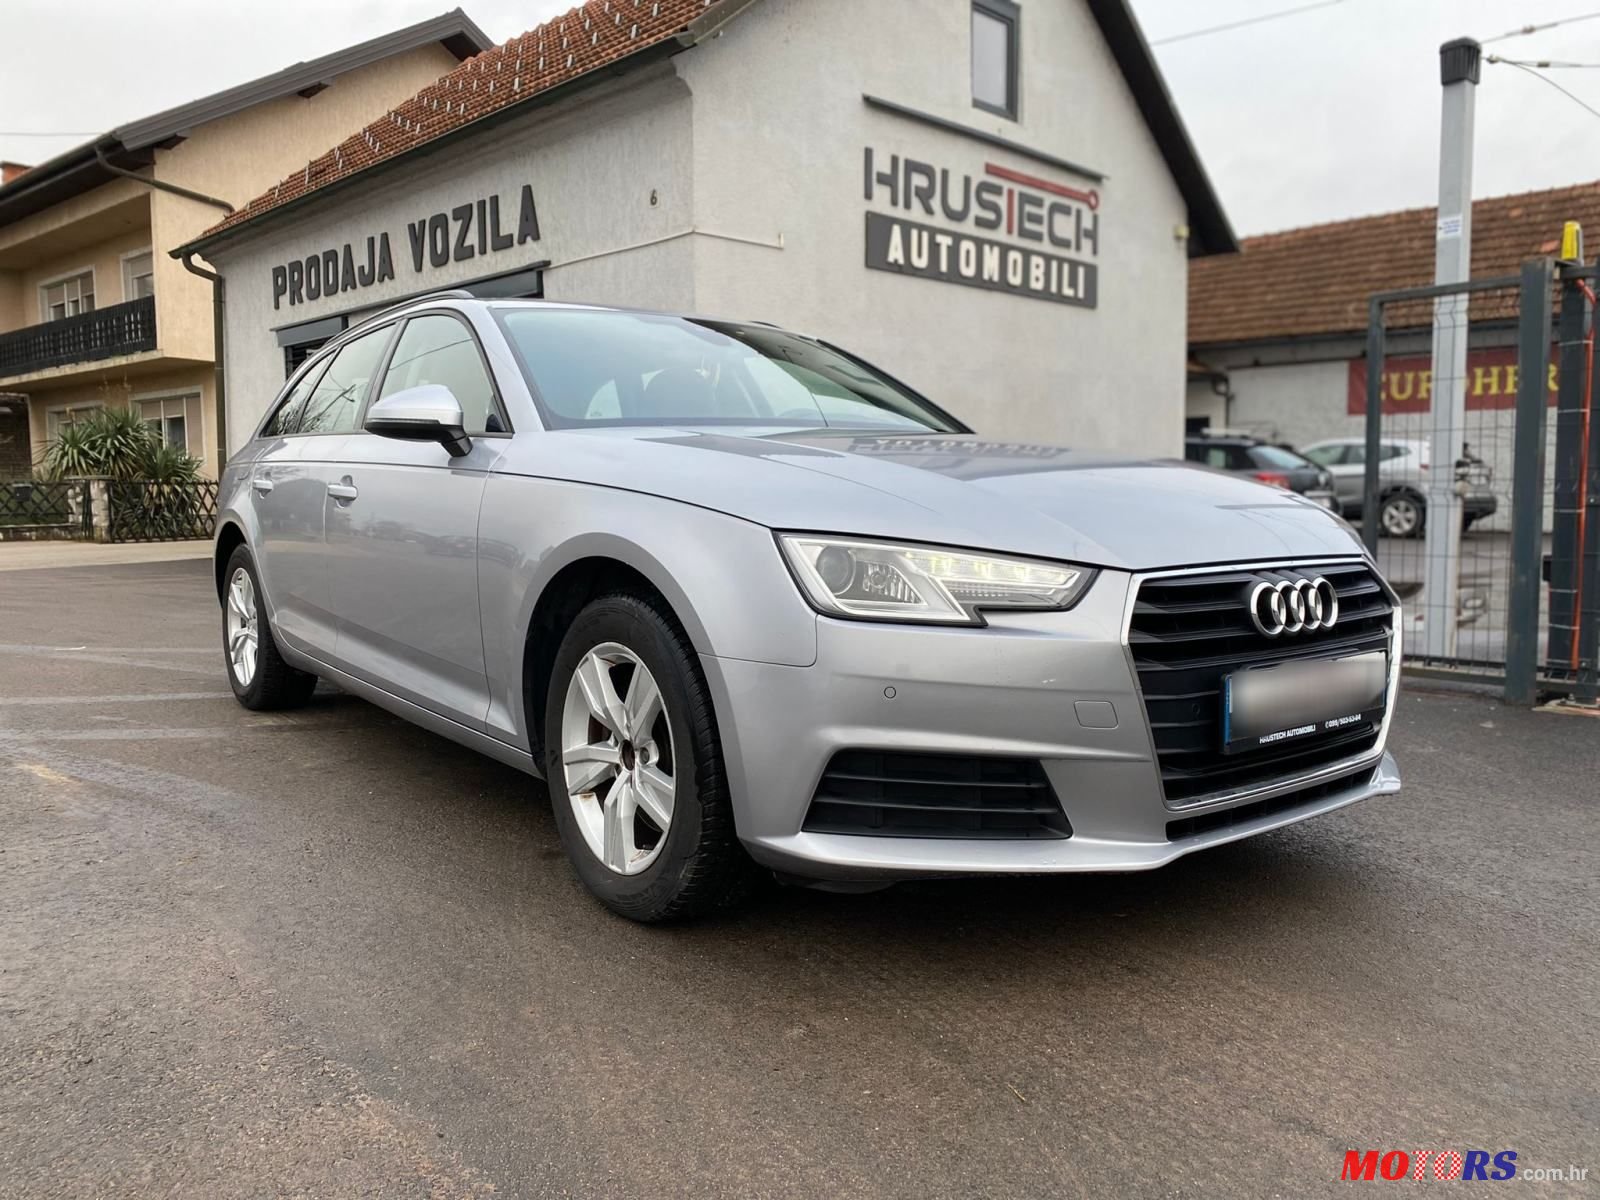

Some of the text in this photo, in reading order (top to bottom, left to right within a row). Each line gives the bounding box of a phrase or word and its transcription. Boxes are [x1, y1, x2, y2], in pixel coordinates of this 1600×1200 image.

[272, 184, 541, 310] PRODAJA VOZILA
[864, 147, 1098, 256] HRUSTECH
[887, 224, 1085, 299] AUTOMOBILI
